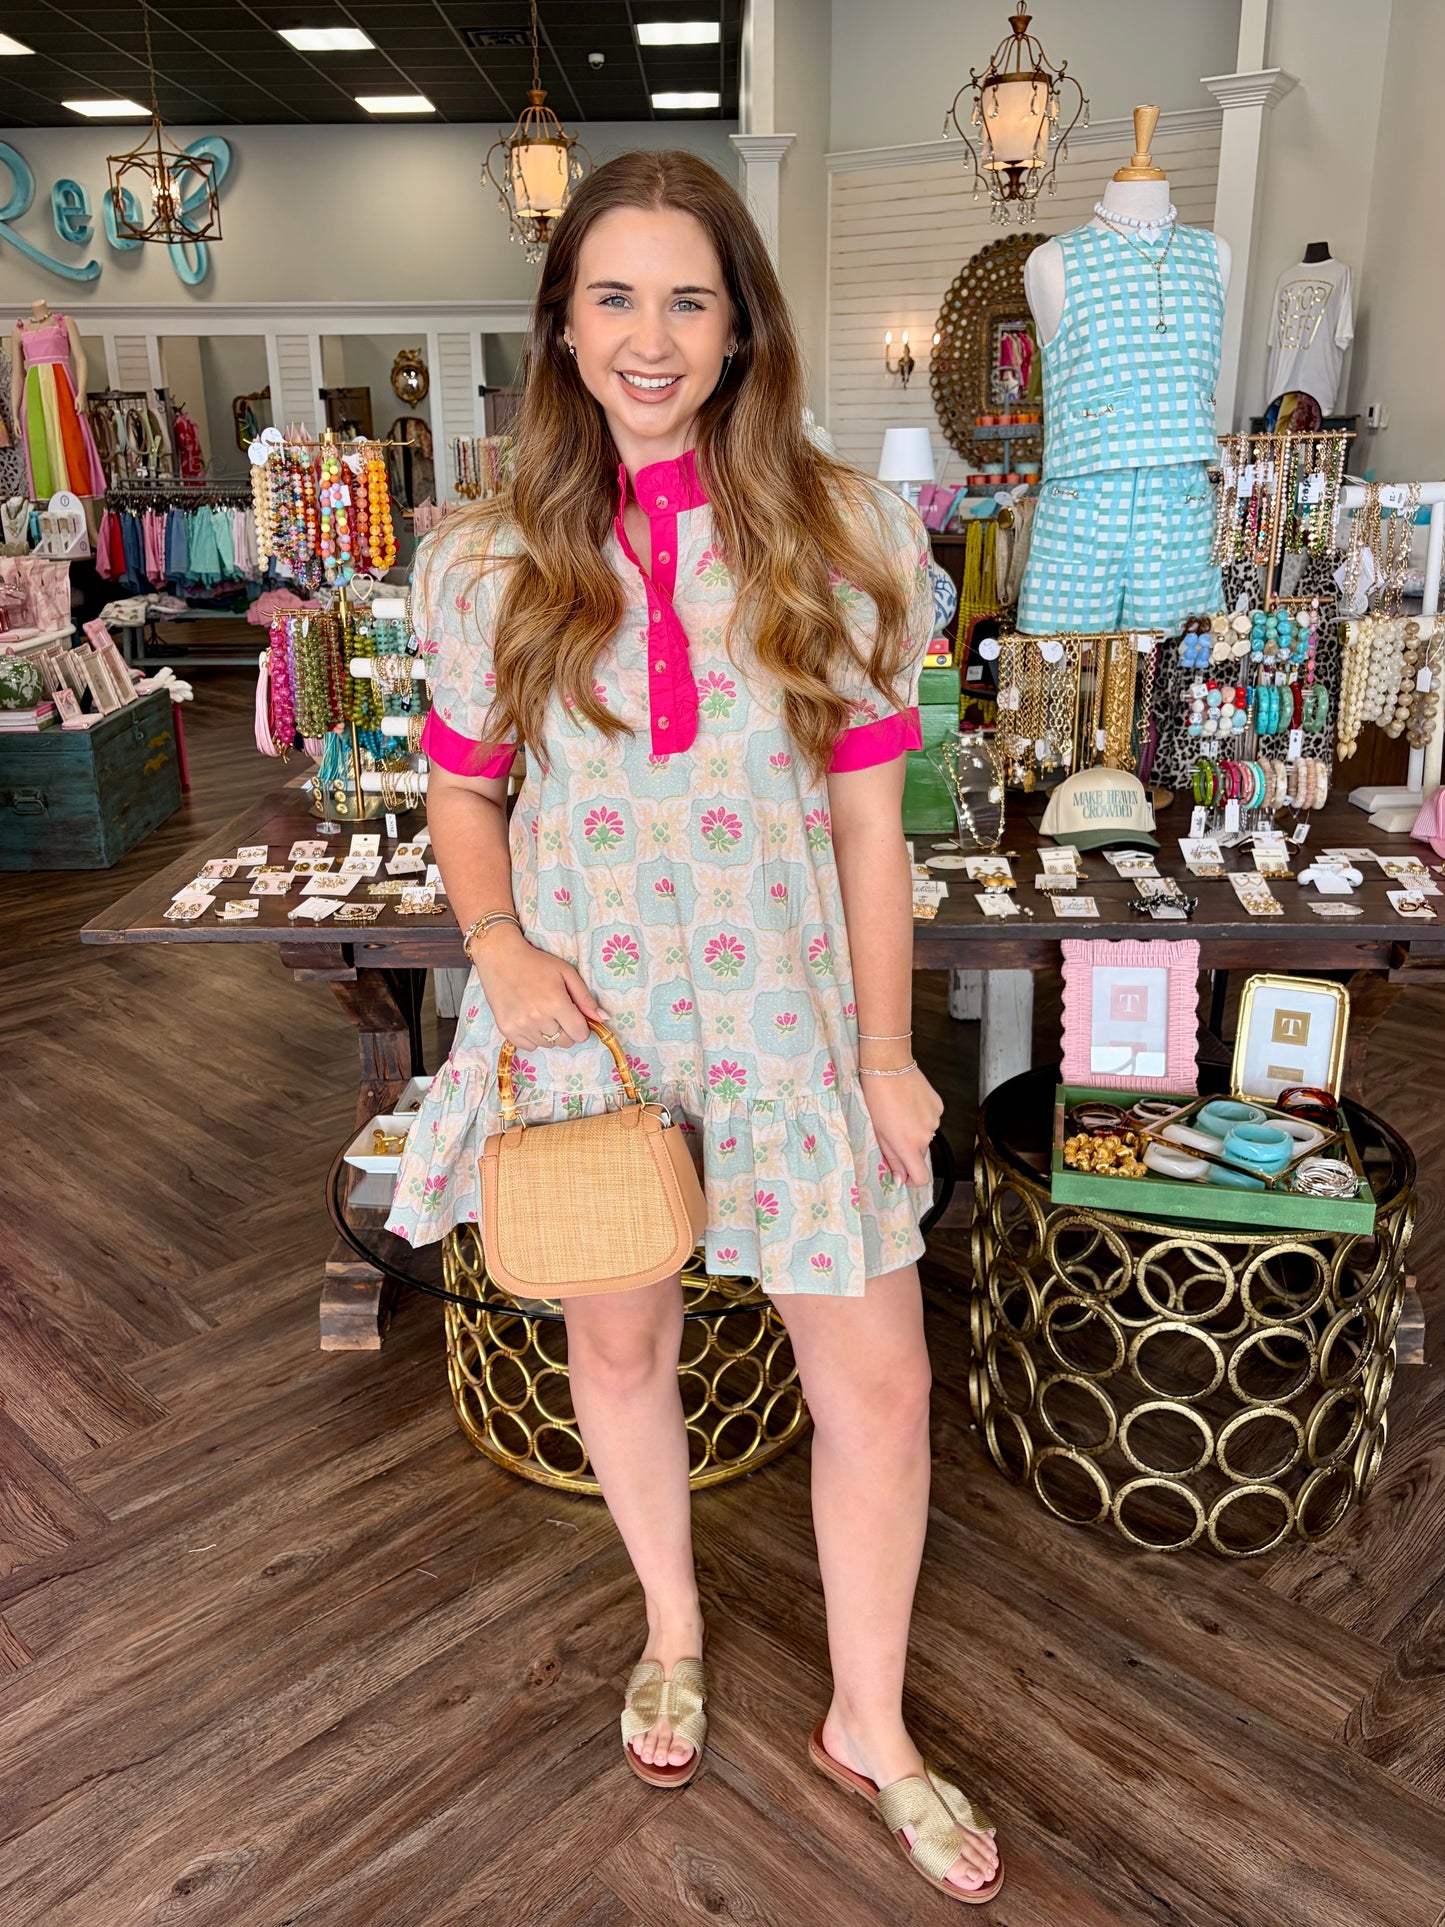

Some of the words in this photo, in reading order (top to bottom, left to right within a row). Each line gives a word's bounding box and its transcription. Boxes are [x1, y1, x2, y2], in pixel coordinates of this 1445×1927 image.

[1073, 790, 1103, 806] MAKE
[1106, 789, 1138, 805] HEAVEN
[1082, 804, 1133, 819] CROWDED
[1119, 993, 1140, 1013] T
[1281, 1017, 1303, 1037] T
